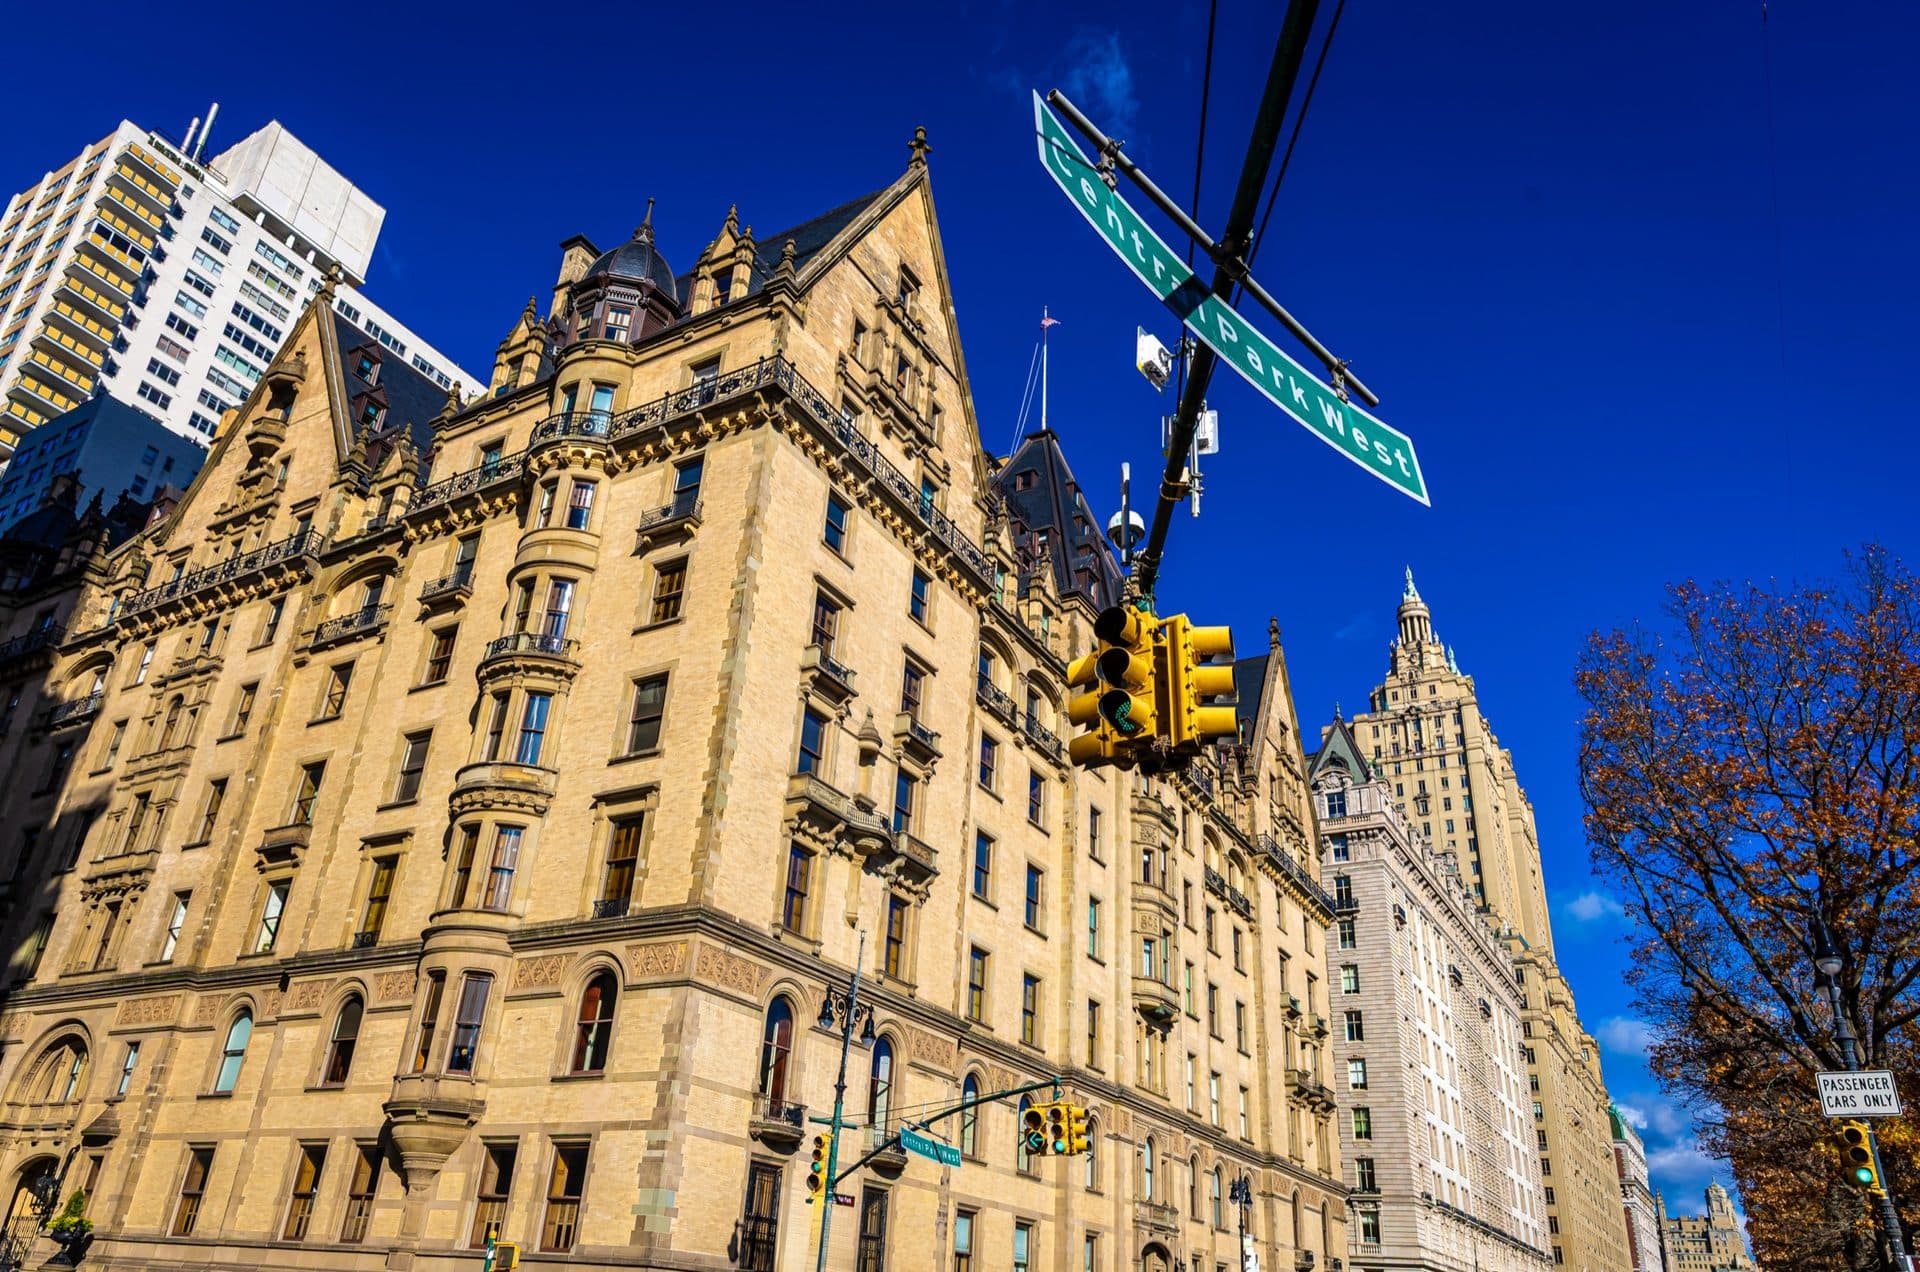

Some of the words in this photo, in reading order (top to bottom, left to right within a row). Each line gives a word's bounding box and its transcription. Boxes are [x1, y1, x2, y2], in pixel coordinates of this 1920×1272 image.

[1216, 312, 1310, 412] Park
[1317, 395, 1411, 478] West
[1823, 1077, 1890, 1091] PASSENGER
[1827, 1095, 1857, 1108] CARS
[1864, 1094, 1892, 1107] ONLY
